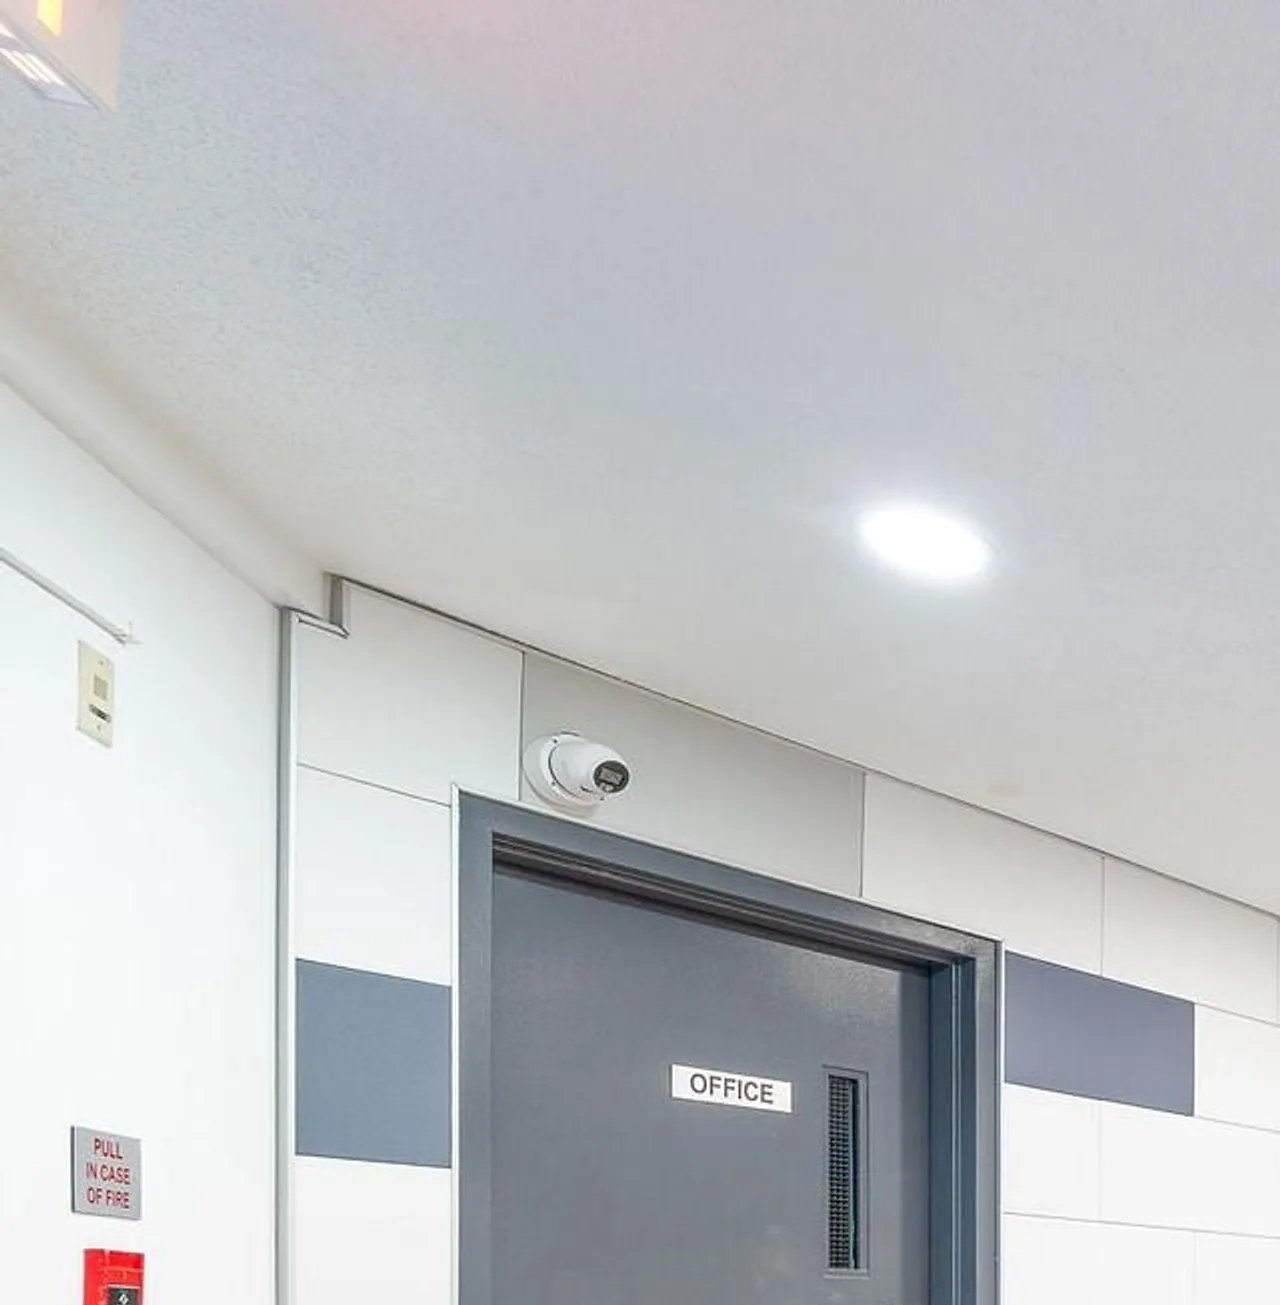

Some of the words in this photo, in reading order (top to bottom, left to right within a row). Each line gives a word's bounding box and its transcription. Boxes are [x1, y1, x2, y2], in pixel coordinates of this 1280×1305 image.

[690, 1073, 773, 1105] OFFICE
[94, 1138, 123, 1159] PULL
[86, 1162, 98, 1179] IN
[100, 1164, 130, 1185] CASE
[87, 1187, 102, 1204] OF
[106, 1190, 130, 1209] FIRE
